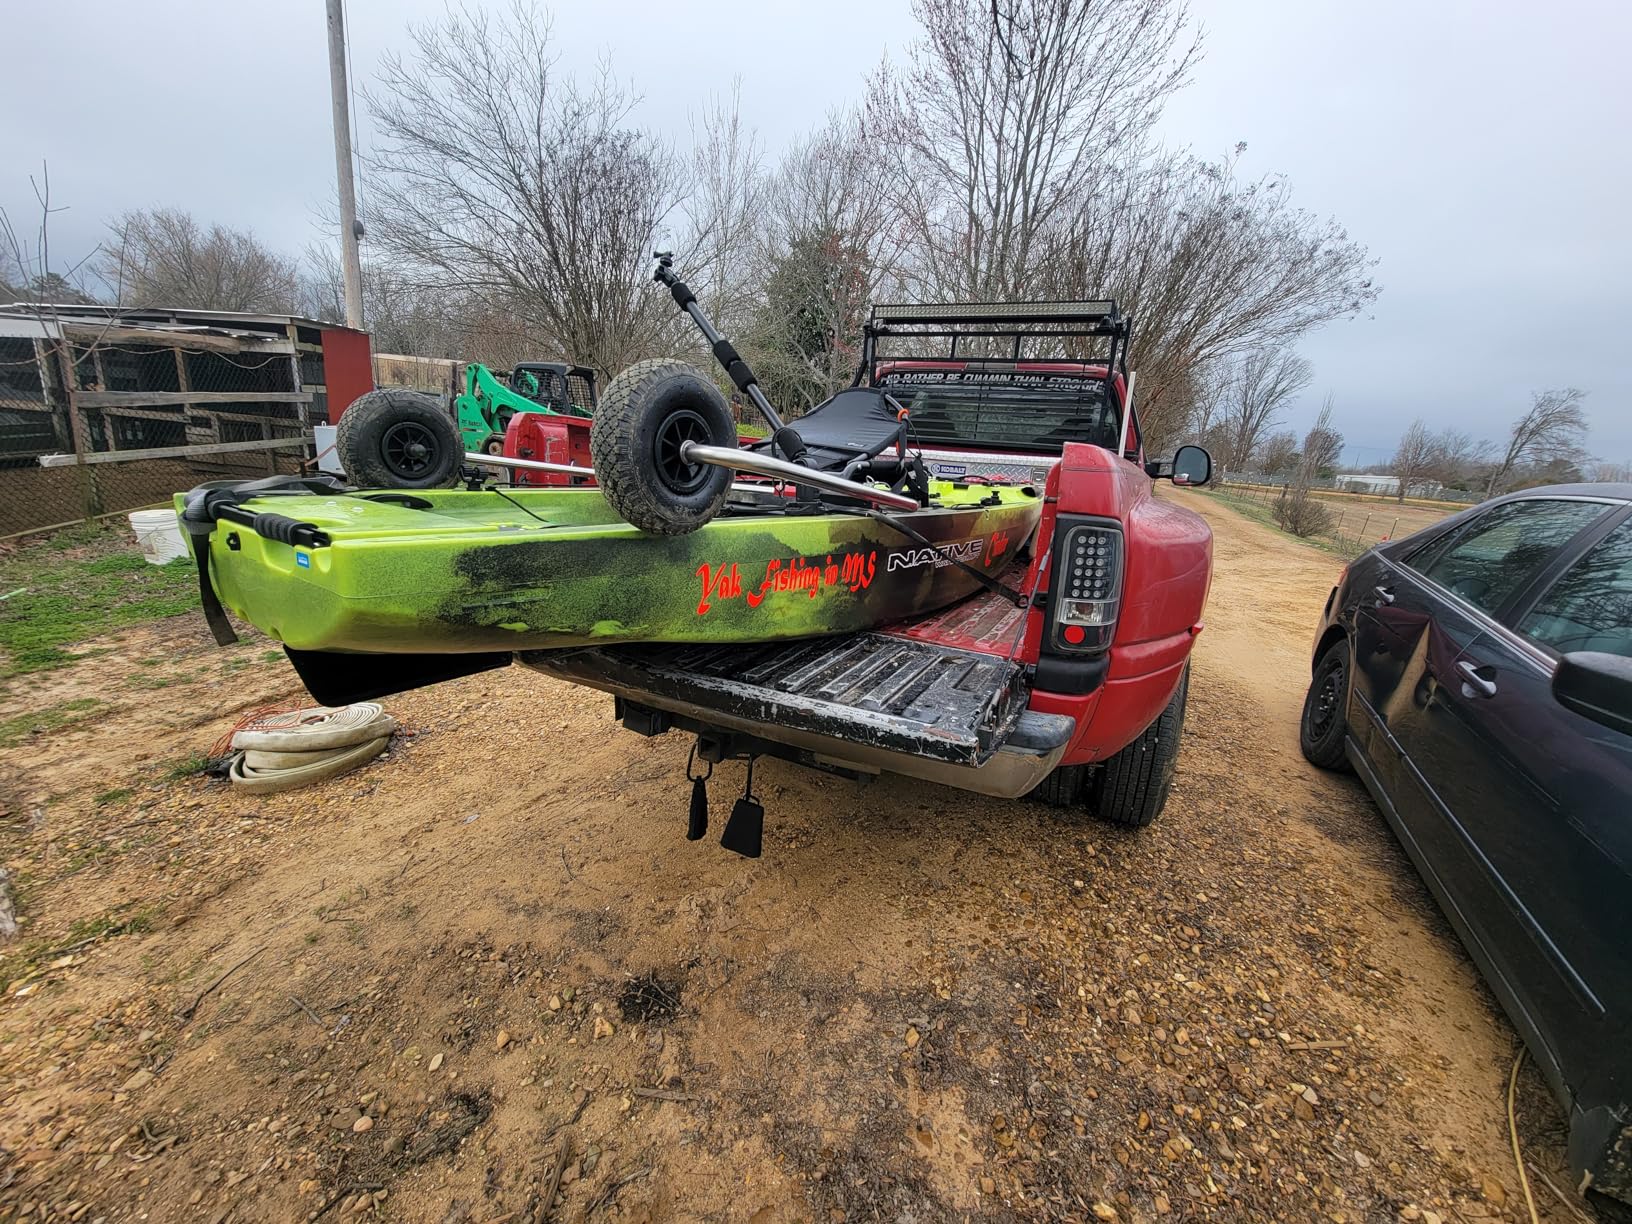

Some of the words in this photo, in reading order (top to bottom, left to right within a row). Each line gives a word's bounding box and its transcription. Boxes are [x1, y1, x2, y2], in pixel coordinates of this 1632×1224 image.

[902, 373, 945, 385] RATHER
[945, 373, 961, 384] BE
[1013, 375, 1044, 387] THAN
[940, 465, 966, 474] KOBALT
[887, 538, 984, 572] NATIVE
[696, 562, 742, 615] Yak
[824, 555, 839, 586] in
[841, 550, 877, 592] MS
